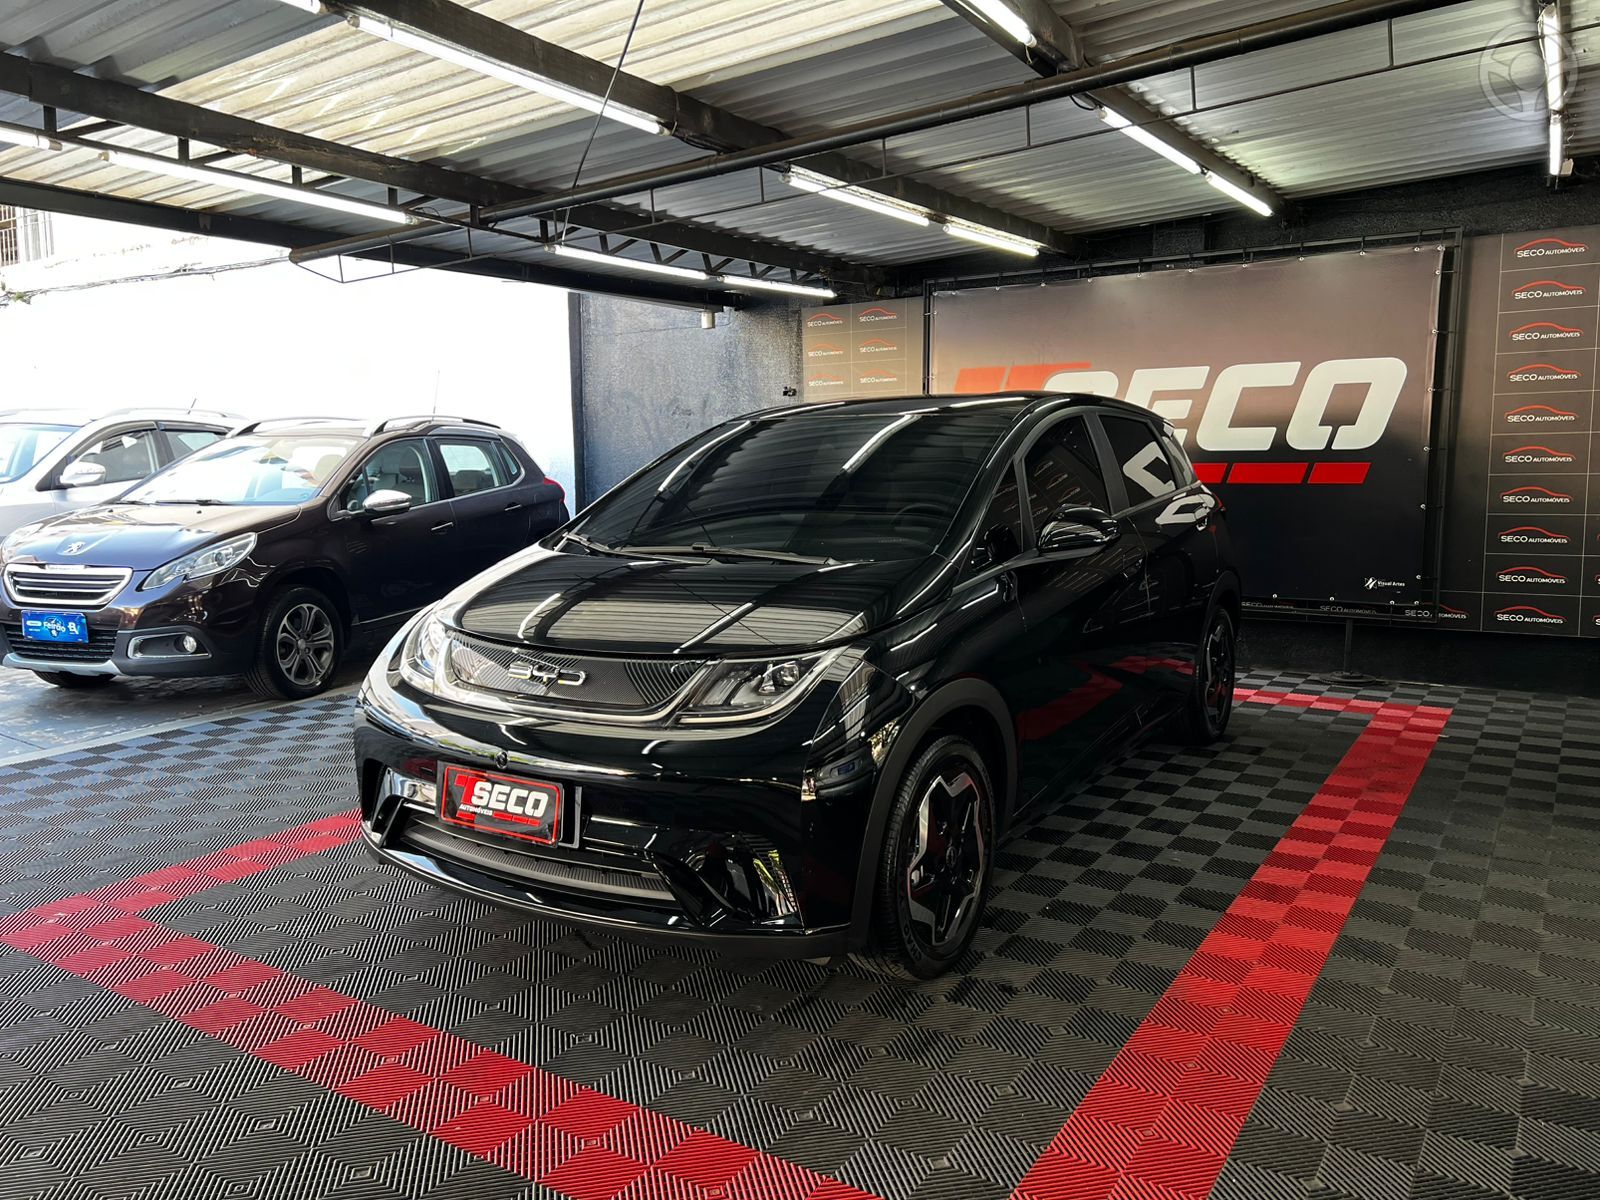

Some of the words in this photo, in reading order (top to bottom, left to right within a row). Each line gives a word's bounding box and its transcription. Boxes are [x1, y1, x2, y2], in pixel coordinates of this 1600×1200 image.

[1517, 249, 1544, 257] SECO
[1545, 247, 1585, 255] AUTOMÓVEIS
[1514, 291, 1542, 299] SECO
[1543, 289, 1582, 297] AUTOMÓVEIS
[1512, 333, 1540, 341] SECO
[508, 660, 586, 686] BYD
[471, 781, 548, 818] SECO
[459, 804, 493, 816] AUTOMÓVEIS
